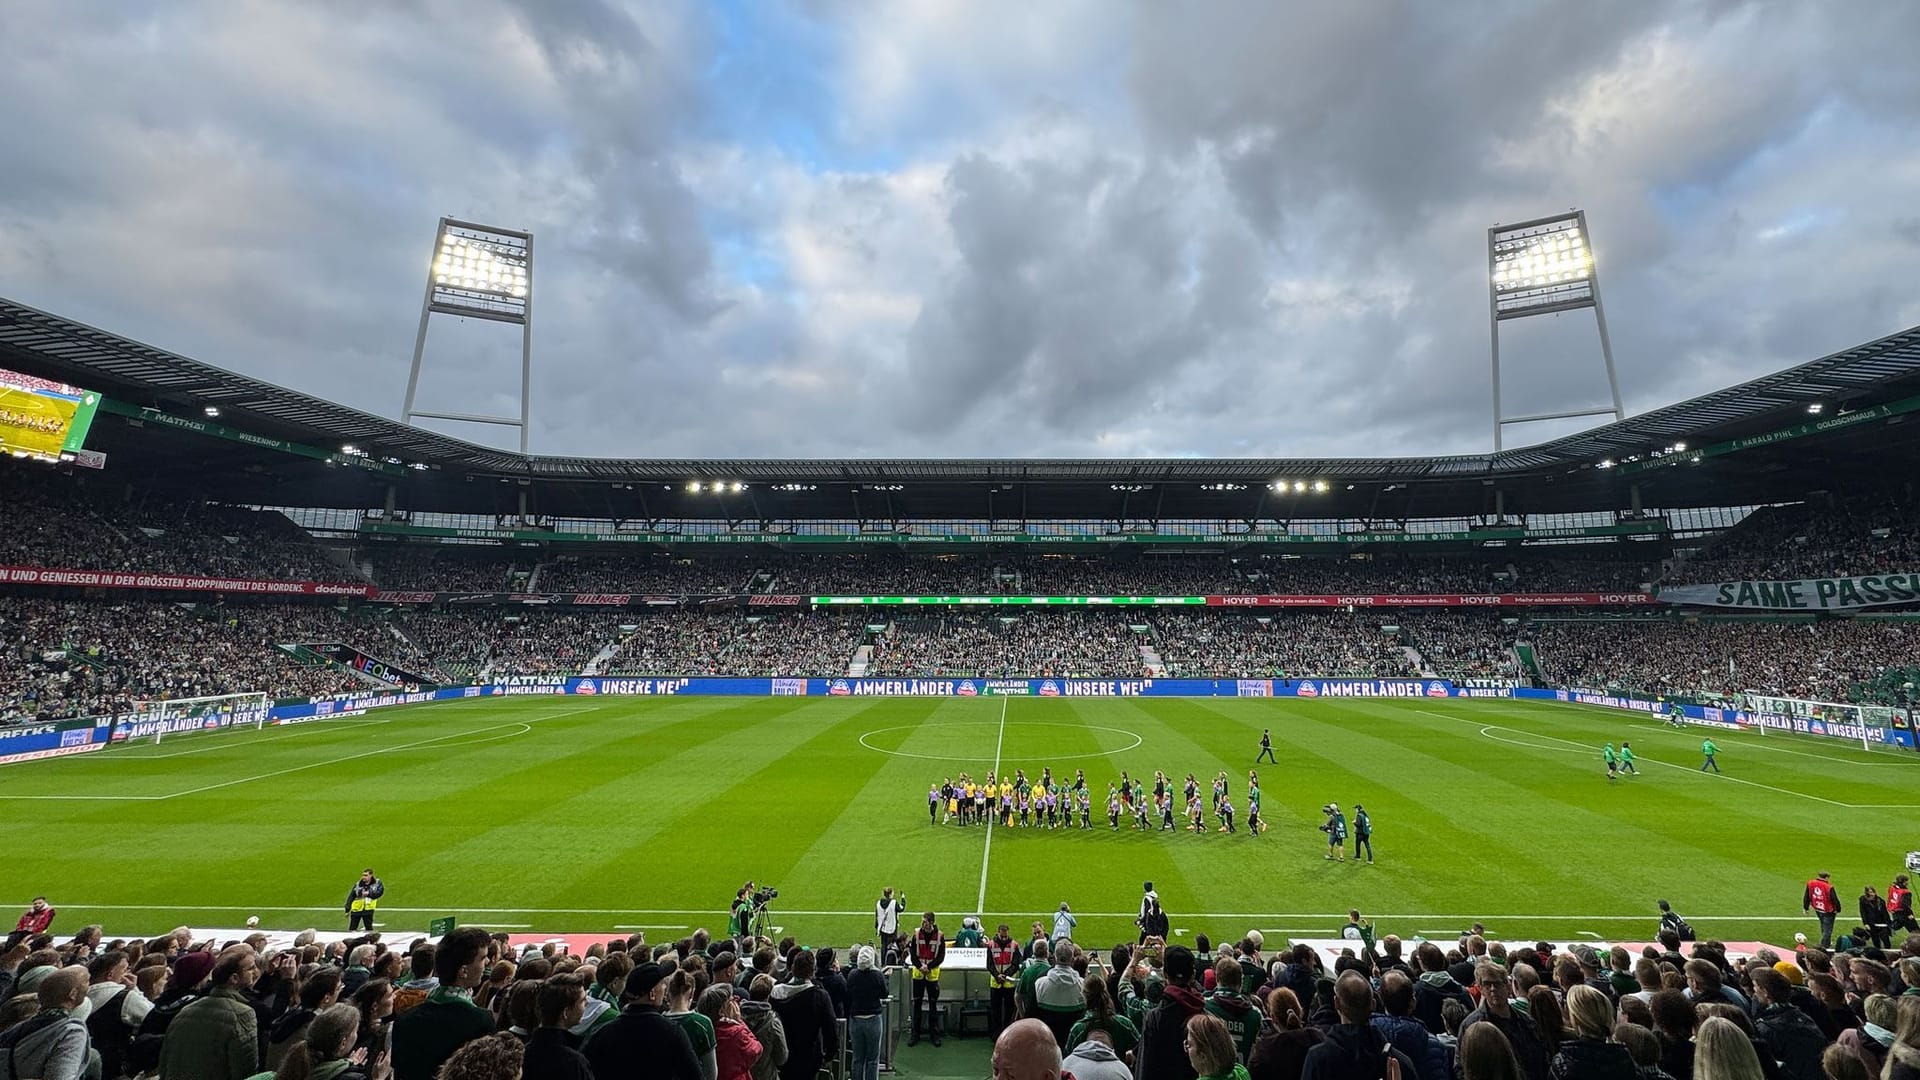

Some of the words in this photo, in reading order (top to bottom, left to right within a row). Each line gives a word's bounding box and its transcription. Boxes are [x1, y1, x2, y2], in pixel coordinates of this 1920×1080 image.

[1816, 410, 1876, 431] GOLDSCHMAUS
[239, 432, 280, 448] WIESENHOF
[1742, 433, 1772, 447] HARALD
[1774, 429, 1793, 441] PIHL
[456, 529, 486, 537] WERDER
[487, 530, 515, 538] BREMEN
[1555, 528, 1585, 536] BREMEN
[11, 570, 38, 582] UND
[40, 571, 100, 585] GENIESSEN
[101, 574, 114, 585] IN
[115, 575, 135, 586] DER
[137, 574, 184, 588] GRÖSSTEN
[186, 578, 250, 591] SHOPPINGWELT
[251, 581, 267, 591] DES
[267, 582, 305, 593] NORDENS.
[315, 584, 367, 595] dodenhof
[1716, 580, 1808, 608] SAME
[573, 594, 631, 605] HILKER
[748, 595, 801, 606] HILKER
[1223, 597, 1258, 605] HOYER
[1337, 597, 1374, 605] HOYER
[1460, 596, 1501, 605] HOYER
[1599, 595, 1647, 603] HOYER
[354, 652, 401, 686] NEObet
[493, 676, 566, 686] MATTHÄI
[602, 680, 651, 695] UNSERE
[854, 678, 954, 696] AMMERLÄNDER
[1064, 681, 1116, 696] UNSERE
[1321, 680, 1423, 697] AMMERLÄNDER
[1448, 679, 1520, 689] ATTHÄI
[505, 685, 554, 695] AMMERLÄNDER
[1470, 689, 1497, 697] UNSERE
[354, 694, 397, 709] AMMERLÄNDER
[406, 692, 426, 703] UNSERE
[1582, 694, 1620, 707] AMMERLÄNDER
[1629, 700, 1652, 712] UNSERE
[129, 716, 204, 738] AMMERLÄNDER
[1827, 725, 1864, 740] UNSERE
